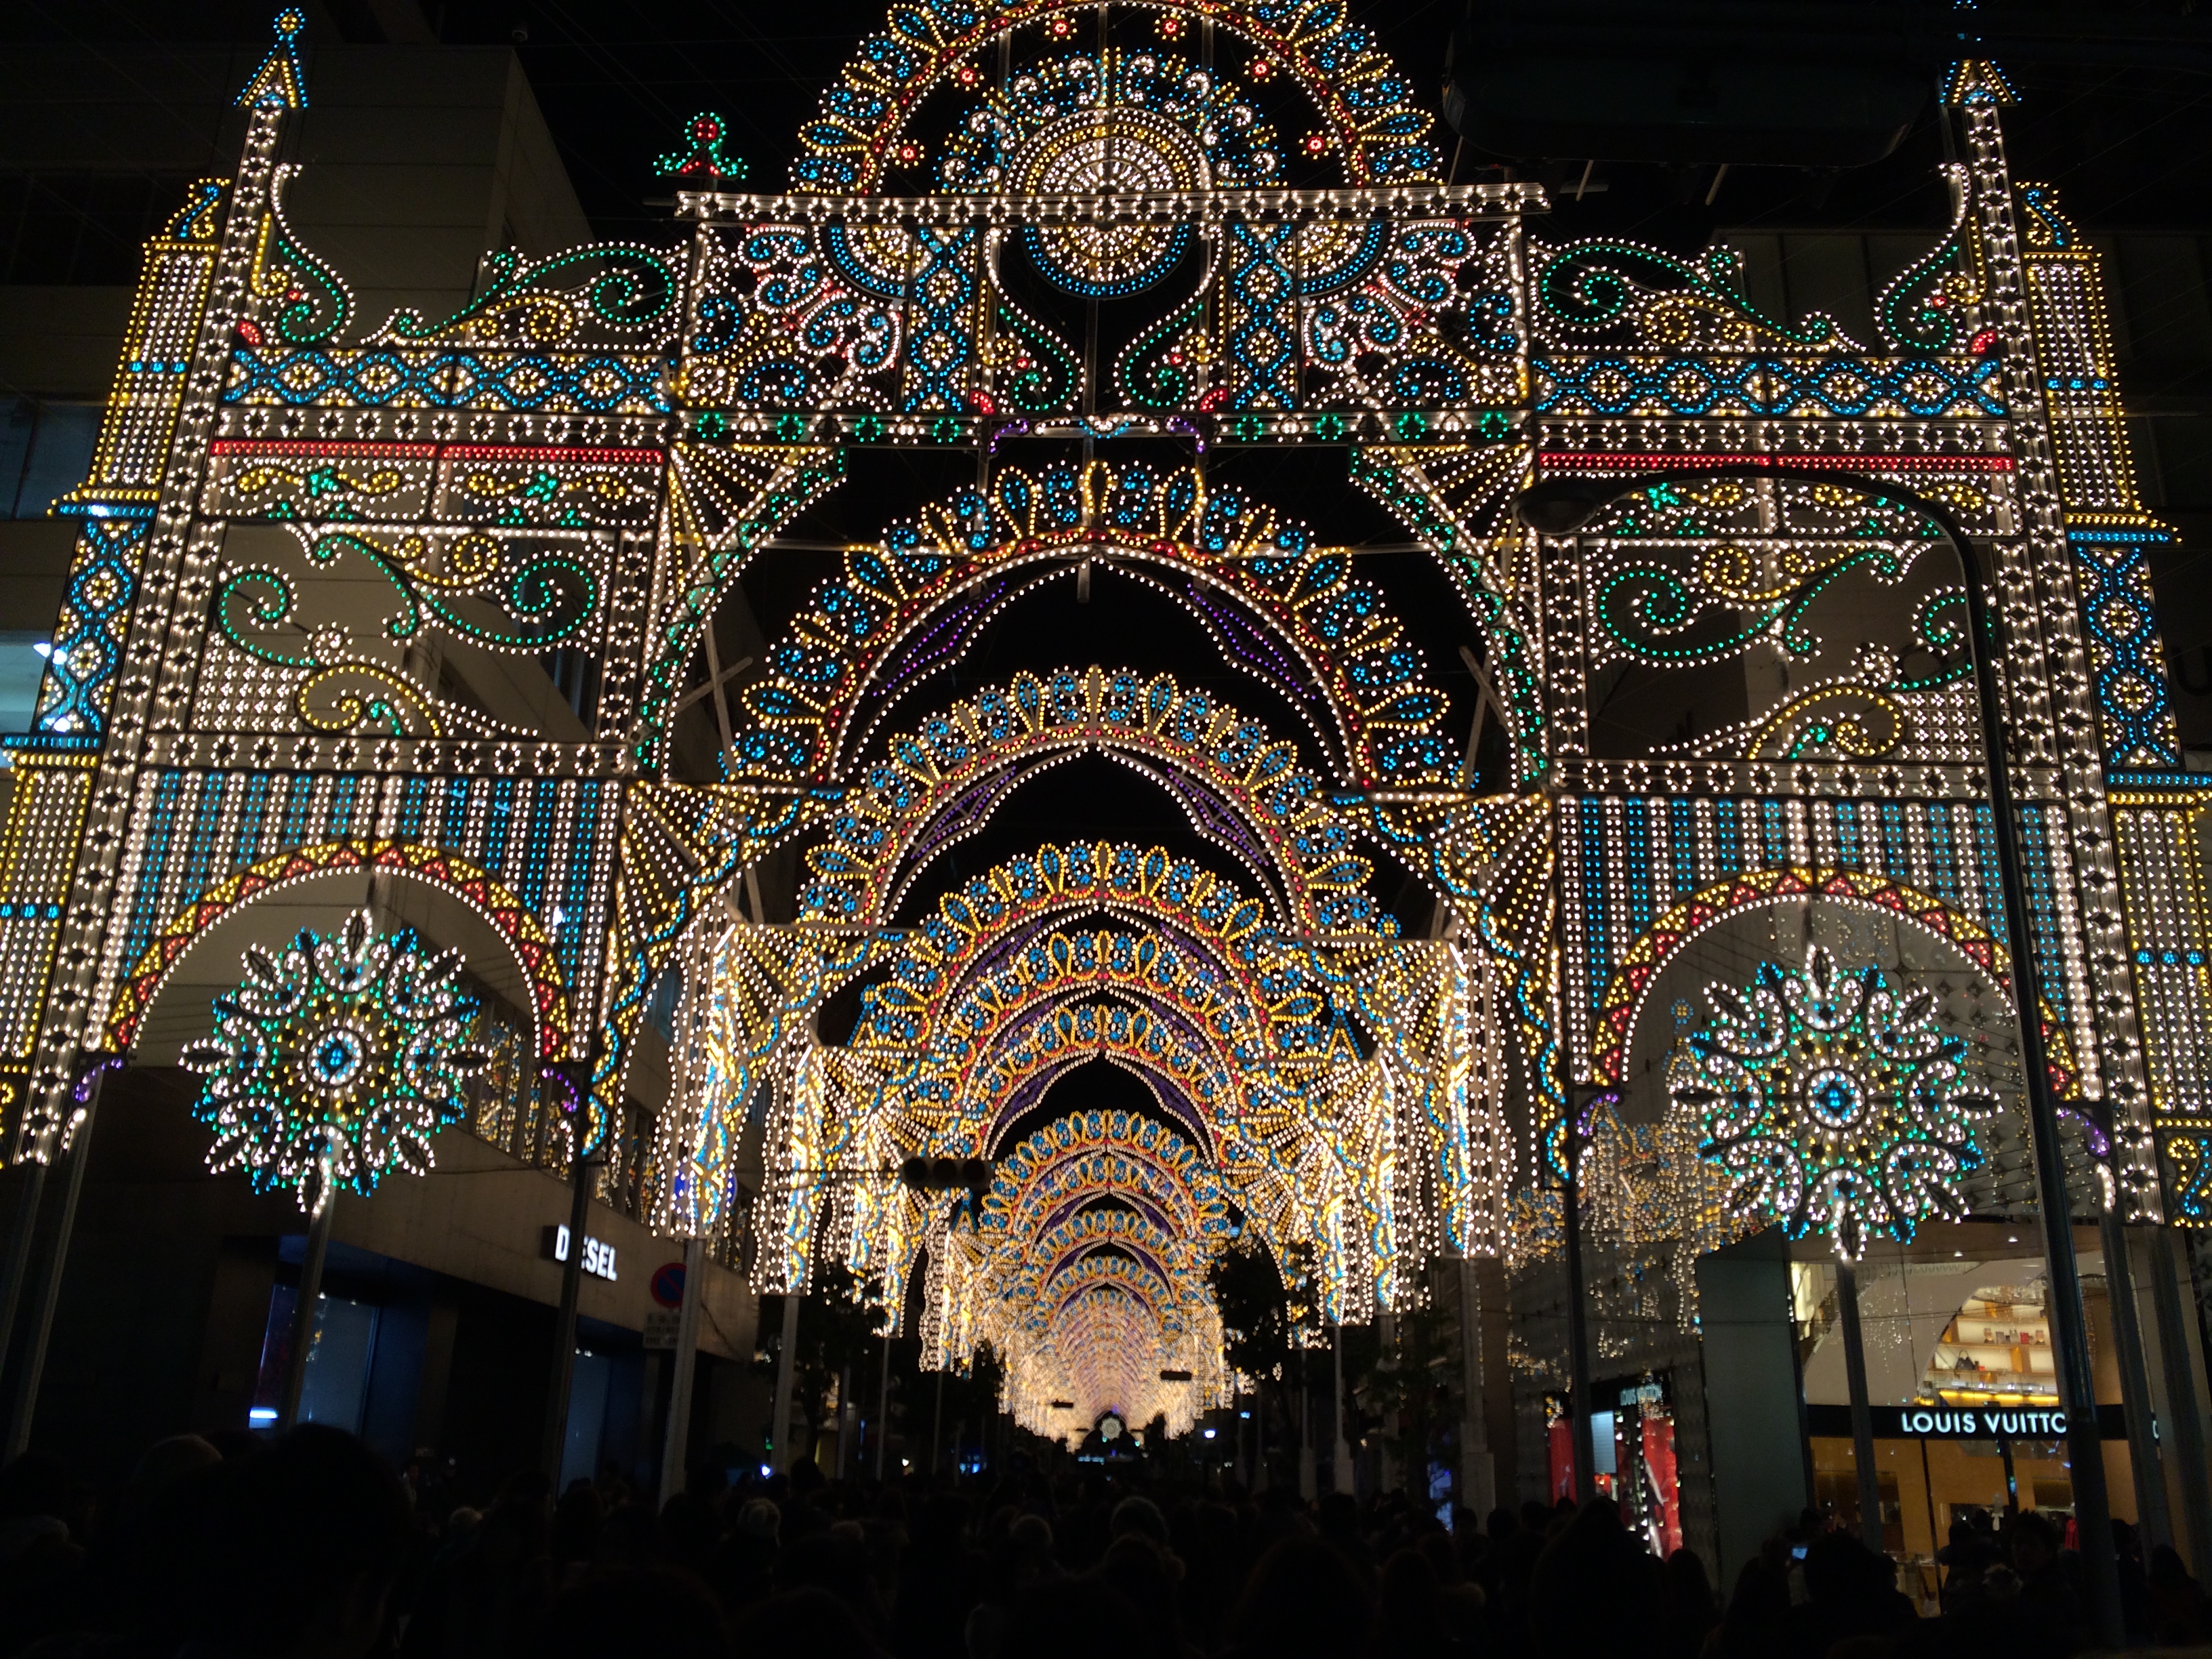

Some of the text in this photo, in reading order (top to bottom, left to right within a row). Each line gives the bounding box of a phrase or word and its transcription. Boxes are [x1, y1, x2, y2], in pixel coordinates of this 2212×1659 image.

[555, 1223, 618, 1282] DSEL
[1902, 1412, 2067, 1434] LOUIS VUITTO
